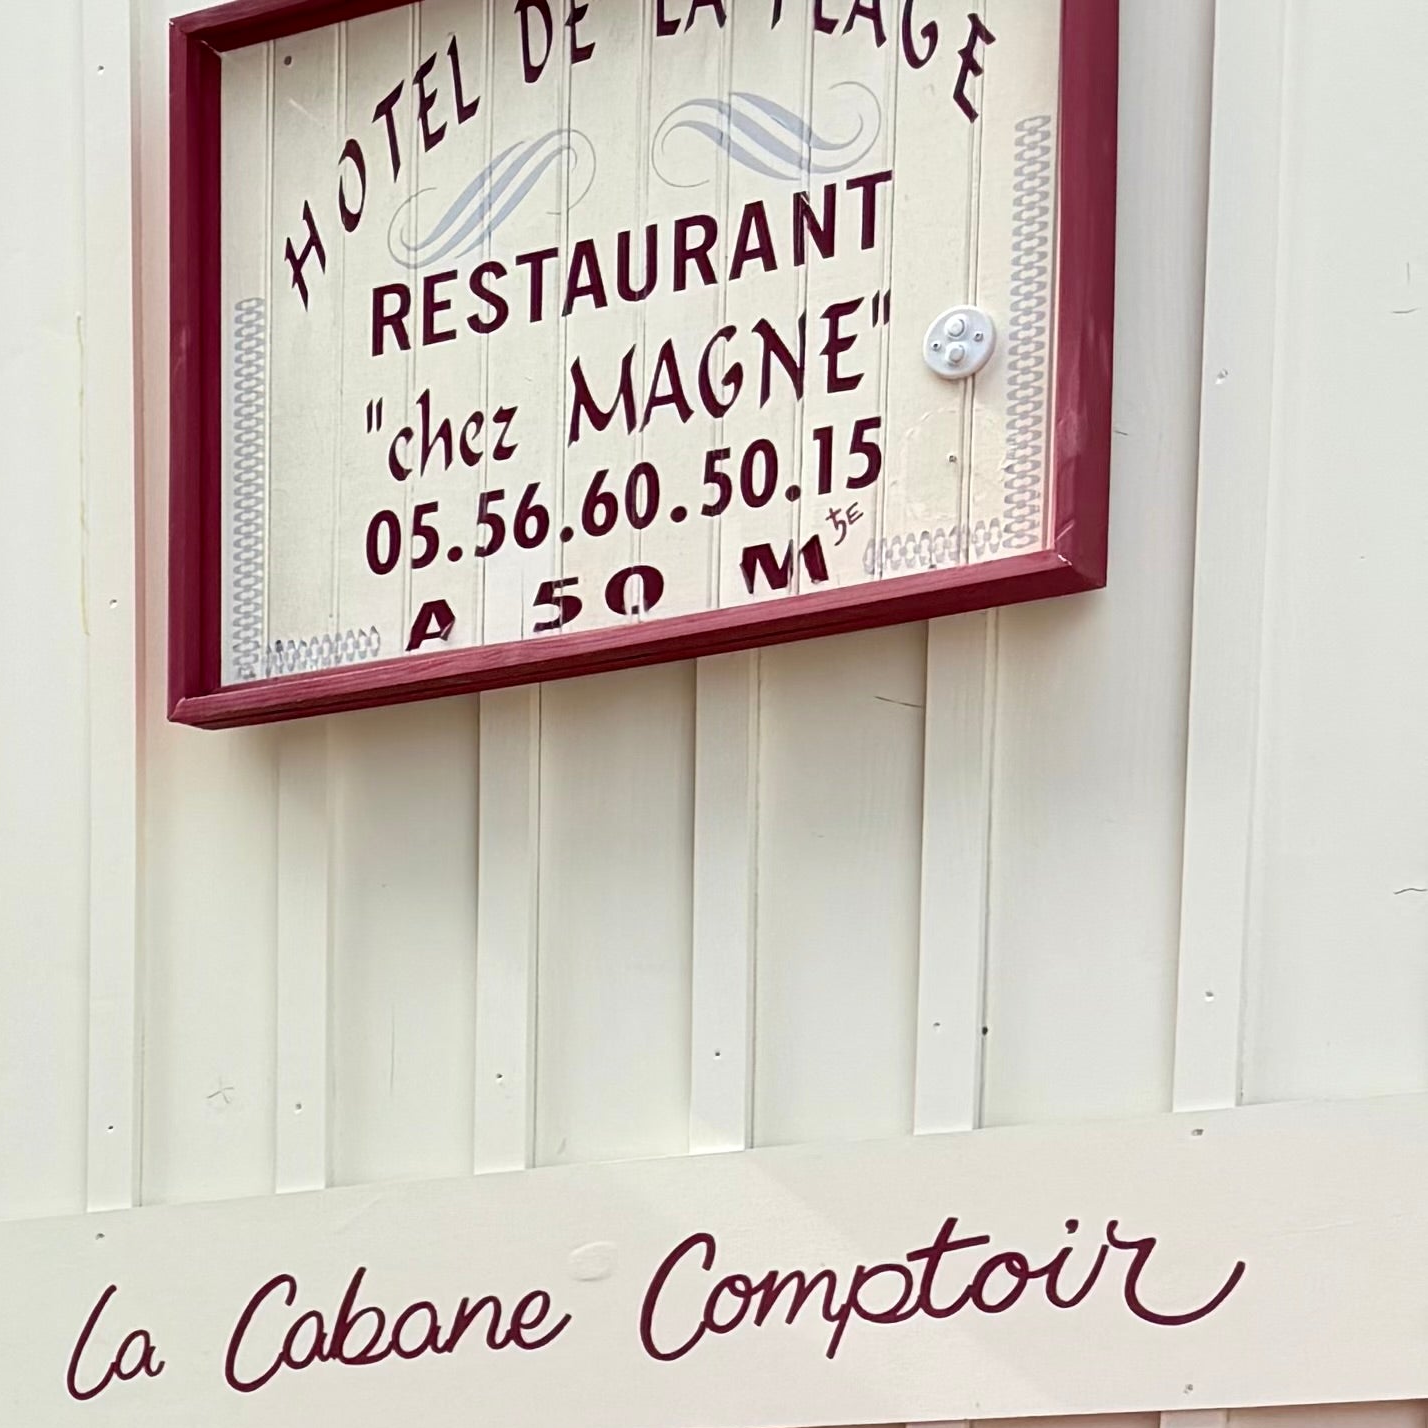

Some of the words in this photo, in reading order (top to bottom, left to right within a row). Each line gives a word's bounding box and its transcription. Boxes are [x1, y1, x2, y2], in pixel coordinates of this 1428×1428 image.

[284, 34, 481, 311] HOTEL
[513, 0, 597, 84] DE
[371, 170, 894, 358] RESTAURANT
[365, 387, 519, 483] "chez
[567, 288, 893, 446] MAGNE"
[365, 415, 884, 577] 05.56.60.50.15
[533, 564, 665, 634] 50
[66, 1283, 166, 1401] La
[224, 1266, 572, 1394] Cabane
[639, 1215, 1246, 1362] Comptoir
